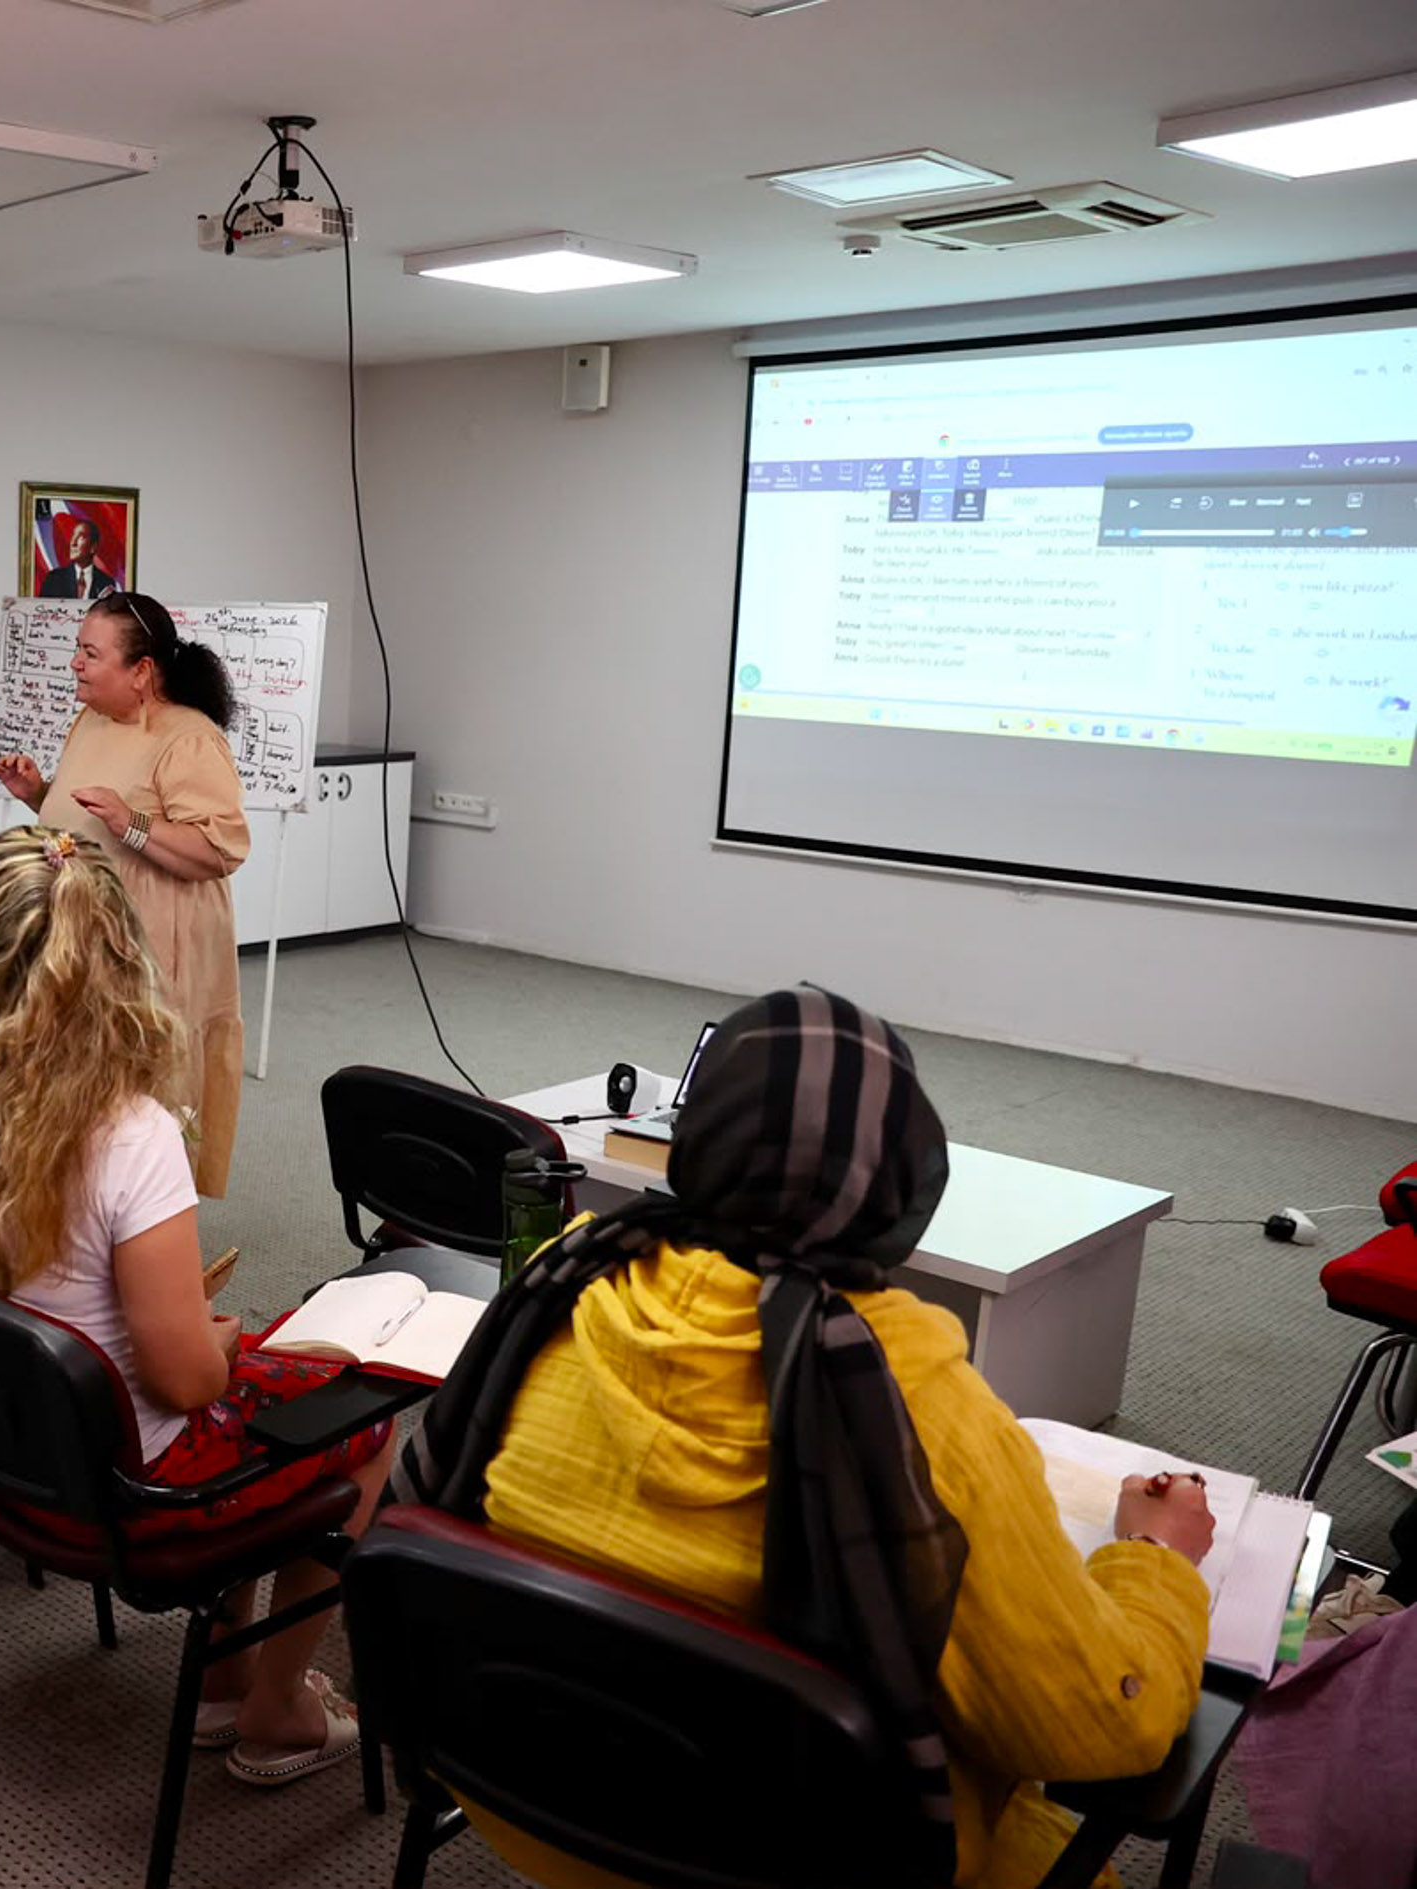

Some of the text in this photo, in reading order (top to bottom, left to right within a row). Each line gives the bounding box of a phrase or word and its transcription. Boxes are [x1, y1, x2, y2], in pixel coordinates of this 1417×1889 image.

[842, 544, 866, 555] Toby
[838, 590, 862, 602] Toby
[1314, 627, 1347, 639] work
[834, 635, 858, 647] Toby
